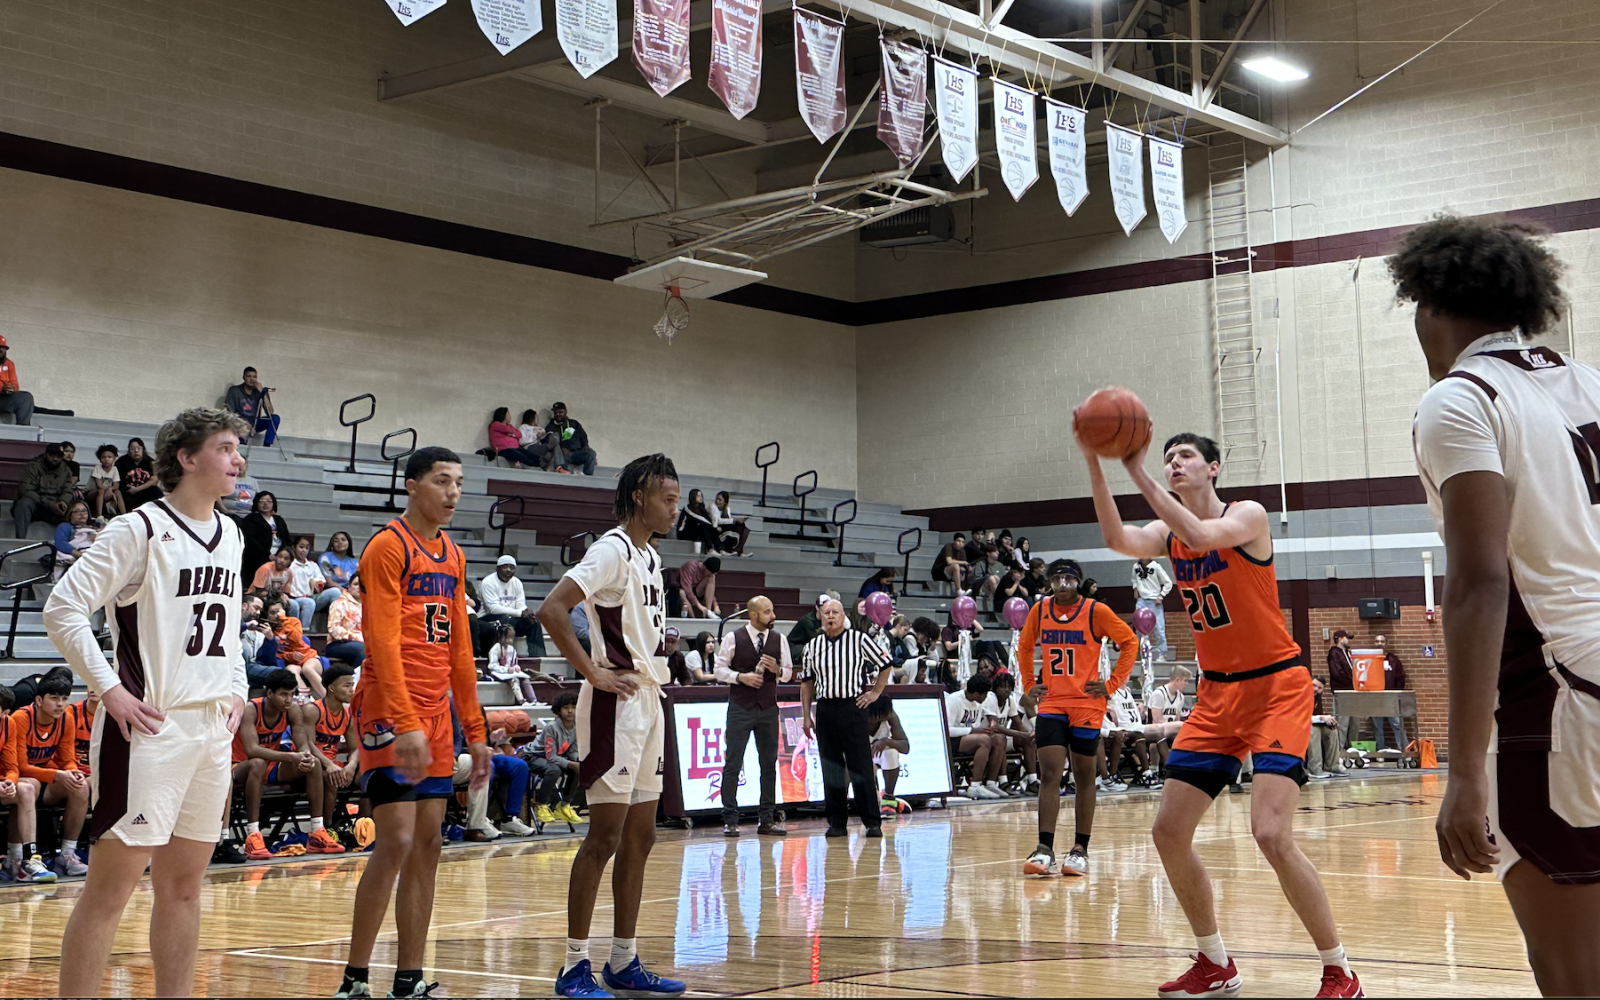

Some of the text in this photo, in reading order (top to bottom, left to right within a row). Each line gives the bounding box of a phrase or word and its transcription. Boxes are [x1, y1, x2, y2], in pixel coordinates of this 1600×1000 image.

[945, 70, 964, 96] LHS
[1005, 91, 1024, 116] LHS
[1055, 110, 1076, 133] LHS
[1116, 133, 1133, 156] LHS
[1158, 146, 1174, 168] LHS
[1181, 581, 1232, 632] 20
[186, 601, 226, 657] 32
[1041, 629, 1087, 645] CENTRAL
[1049, 647, 1075, 676] 21
[688, 717, 727, 780] LH
